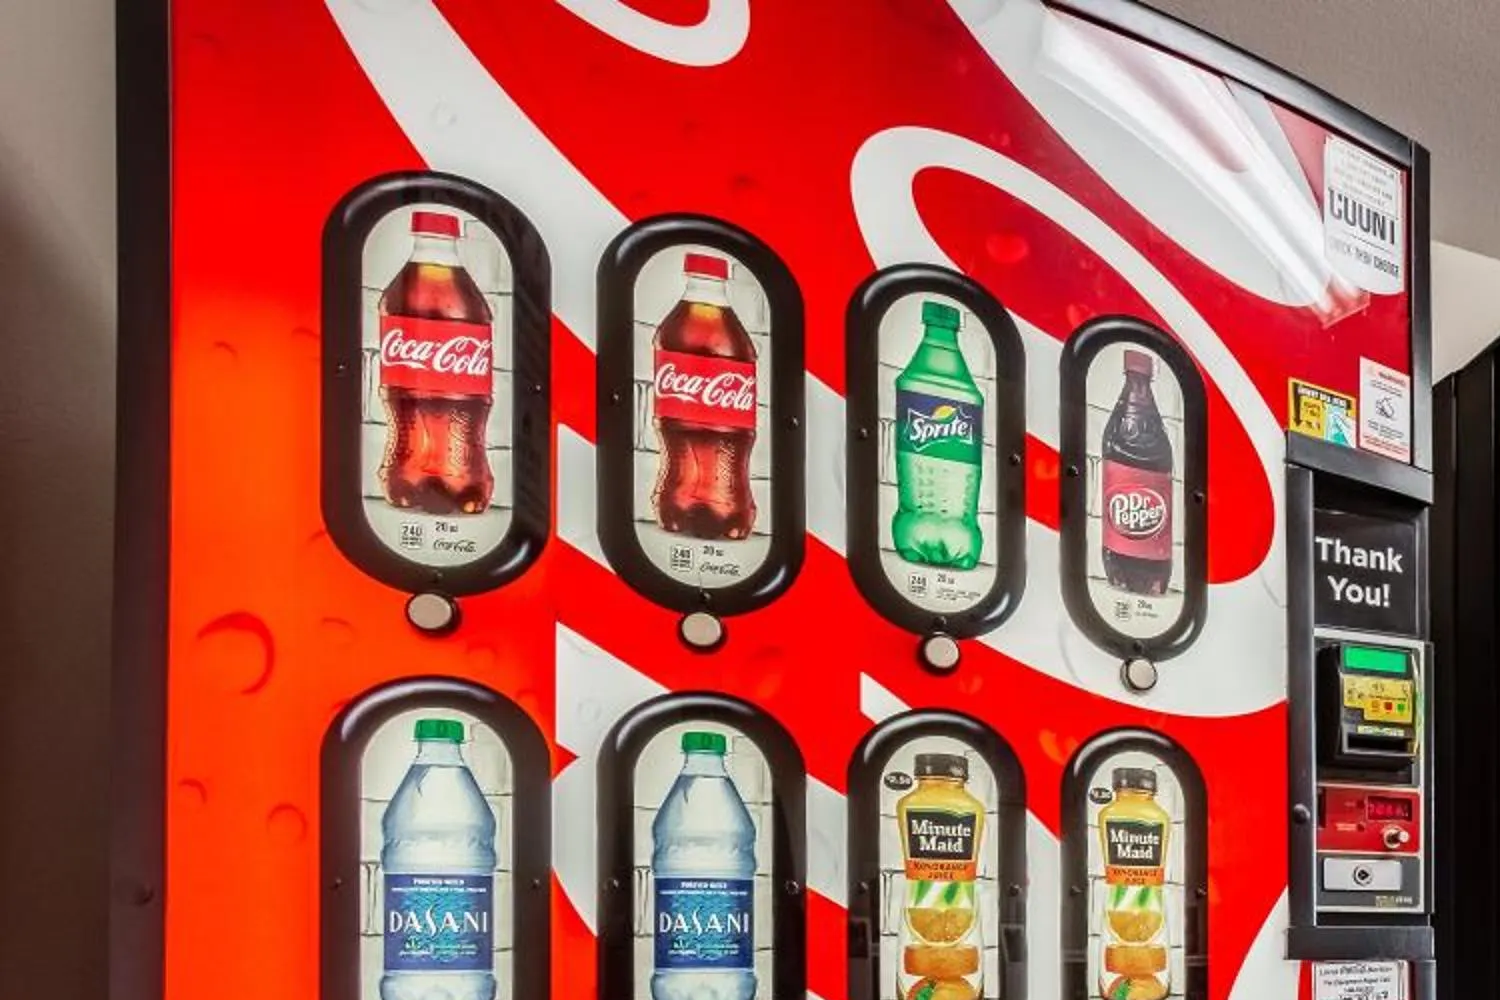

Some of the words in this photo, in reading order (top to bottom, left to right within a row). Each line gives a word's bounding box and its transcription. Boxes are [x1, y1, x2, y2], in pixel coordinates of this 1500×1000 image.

[381, 328, 490, 376] Coca-Cola
[655, 363, 756, 411] Coca-Cola
[910, 417, 969, 443] Sprite
[1110, 494, 1164, 528] Pepper
[1315, 536, 1403, 574] Thank
[1327, 575, 1391, 608] You!
[911, 819, 972, 837] Minute
[1110, 828, 1160, 845] Minute
[919, 835, 964, 853] Maid
[1117, 843, 1154, 859] Maid
[389, 905, 488, 936] DASANI
[659, 907, 749, 936] DASANI
